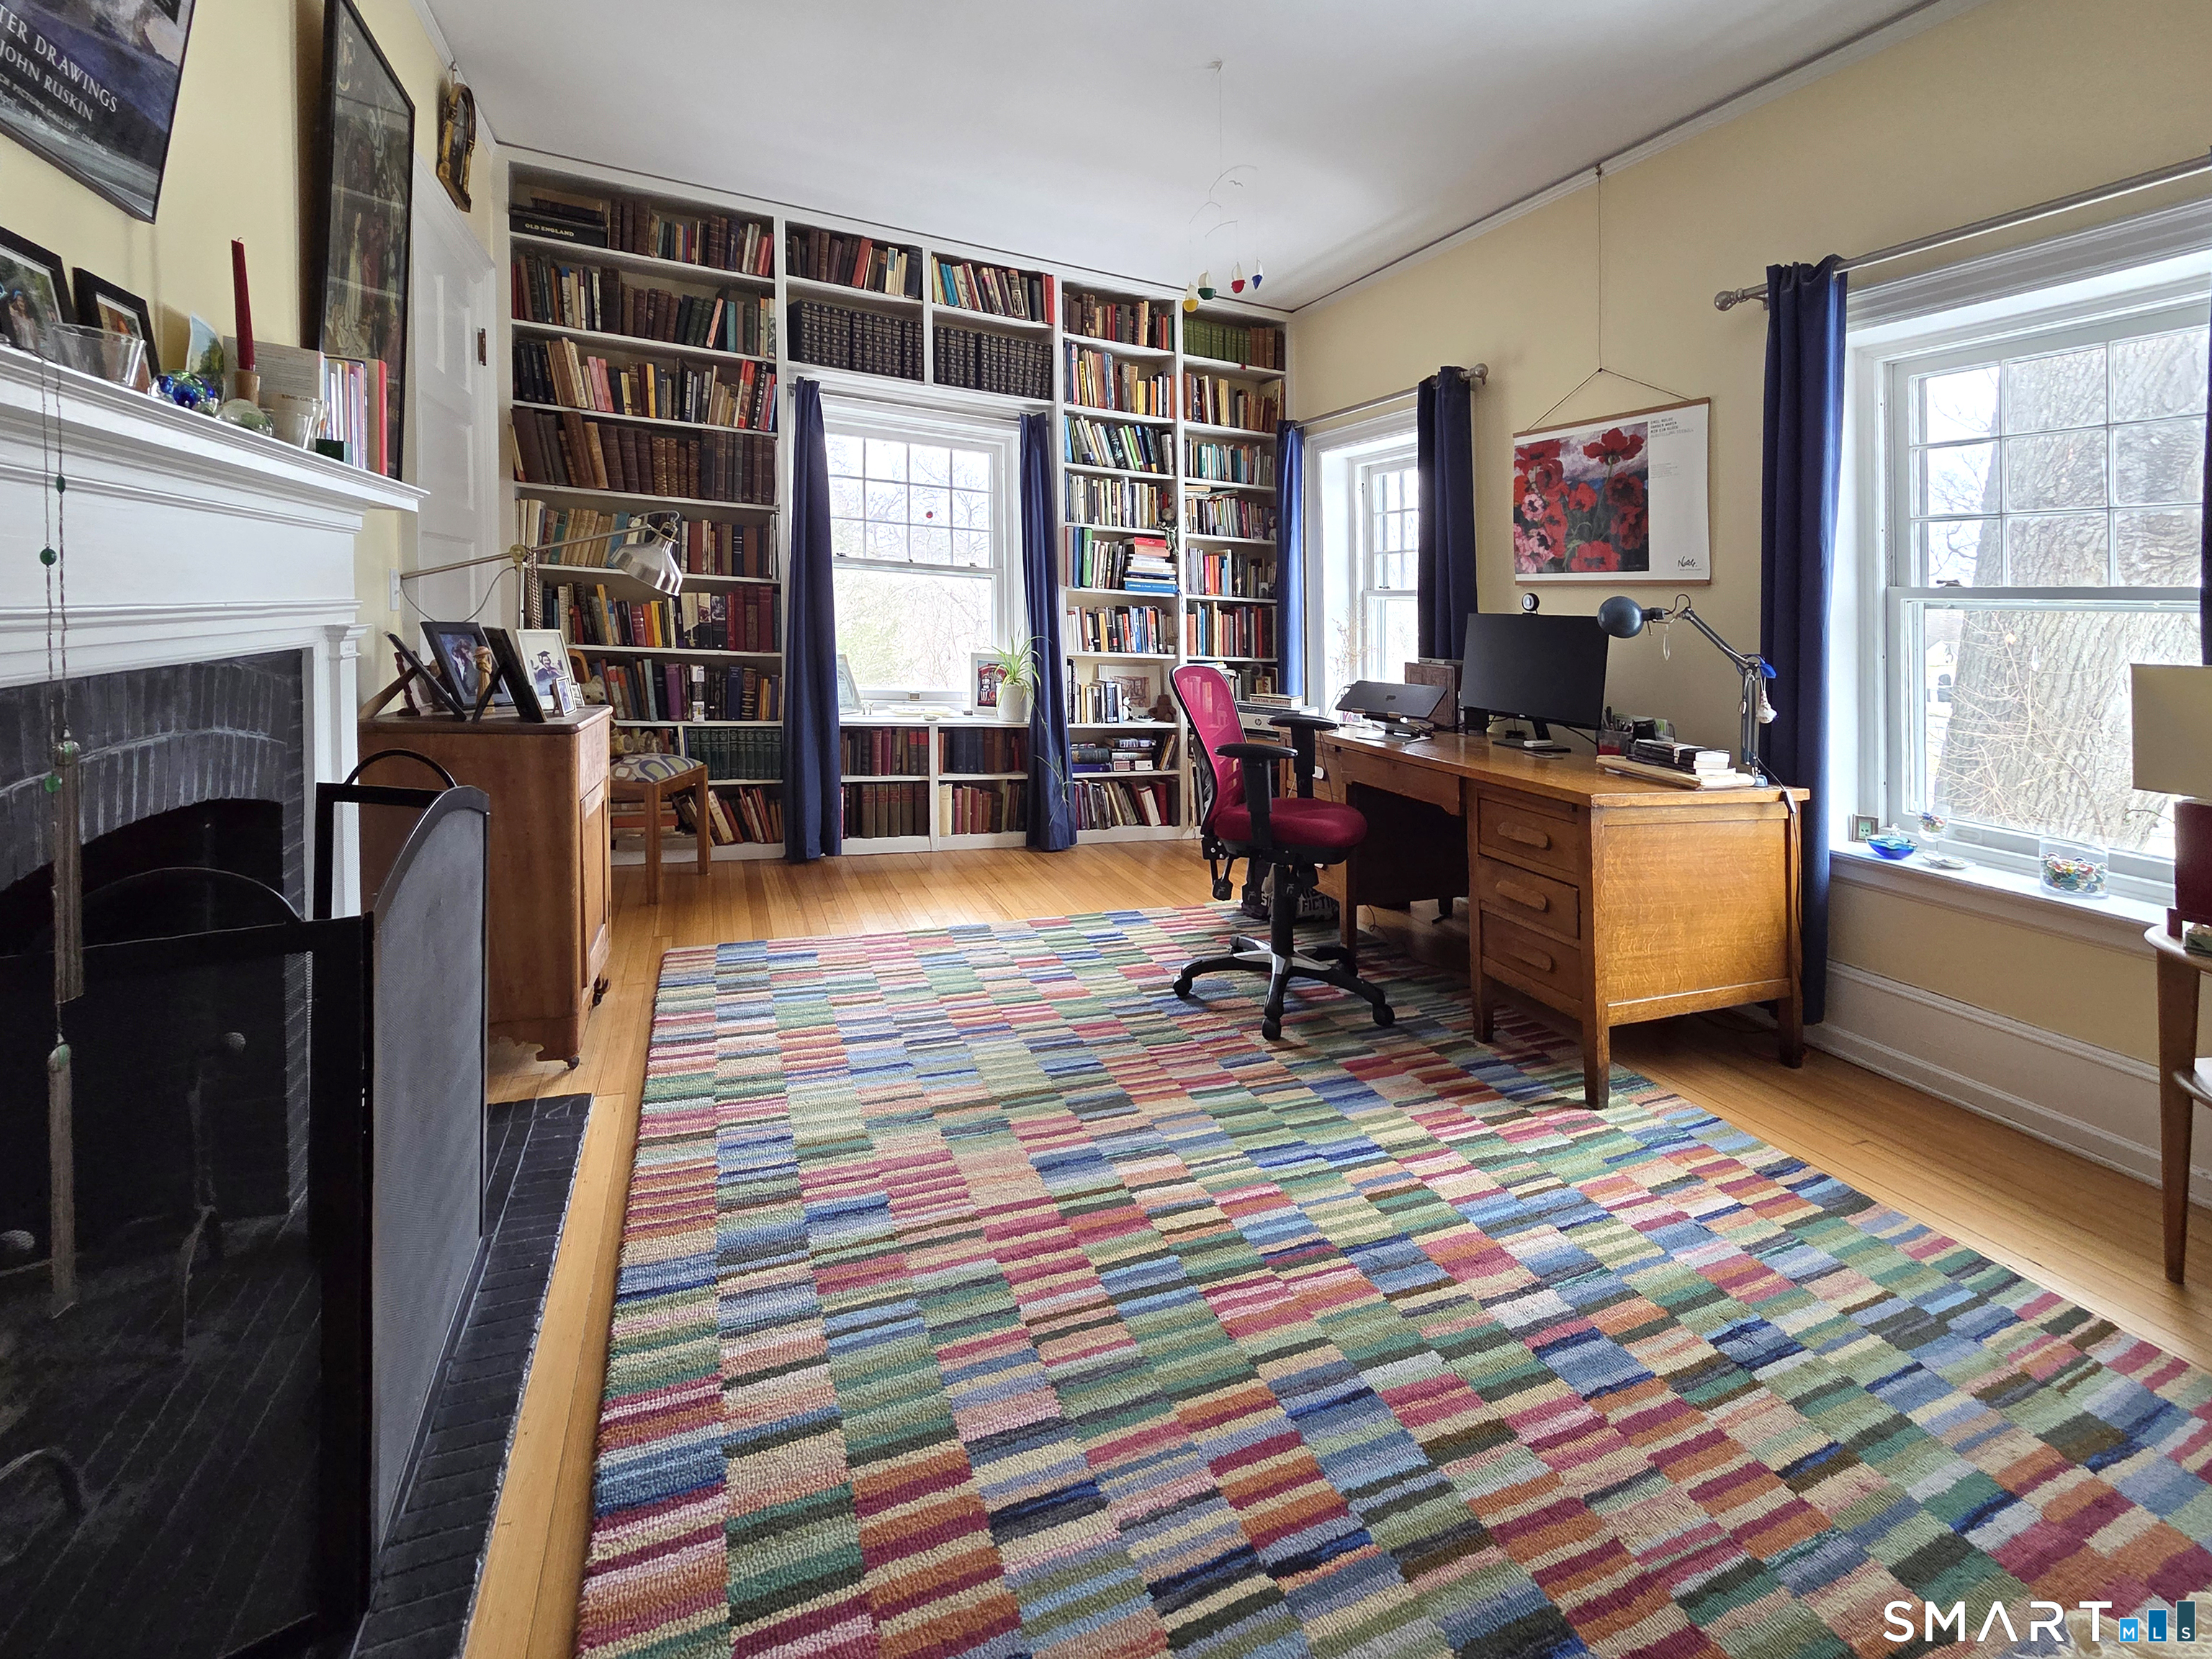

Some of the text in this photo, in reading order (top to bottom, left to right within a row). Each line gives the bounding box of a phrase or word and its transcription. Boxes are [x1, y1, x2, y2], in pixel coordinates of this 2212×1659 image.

[0, 39, 94, 122] JOHN RUSKIN
[35, 34, 118, 112] DRAWINGS
[541, 225, 575, 237] ENGLAND
